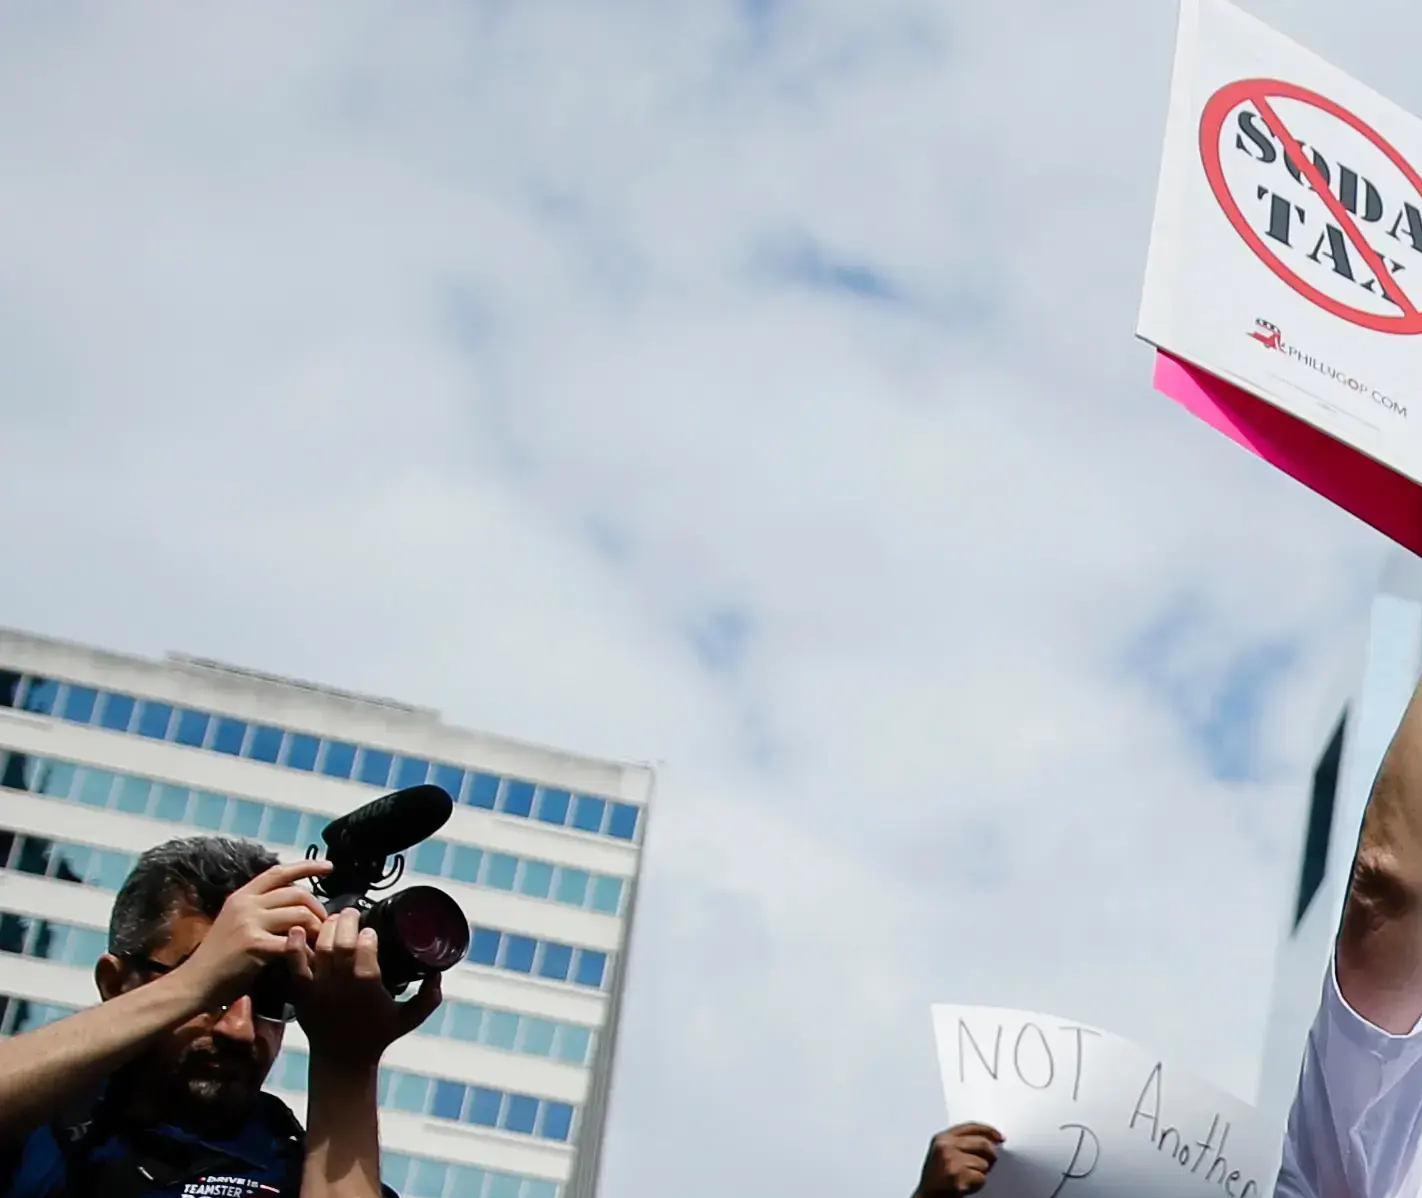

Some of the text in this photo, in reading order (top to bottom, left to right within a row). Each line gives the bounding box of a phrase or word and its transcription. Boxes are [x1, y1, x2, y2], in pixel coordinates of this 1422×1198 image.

[1257, 185, 1406, 305] TAX
[958, 1017, 1103, 1102] NOT
[183, 1184, 242, 1198] TEAMSTER
[207, 1176, 246, 1186] DRIVE
